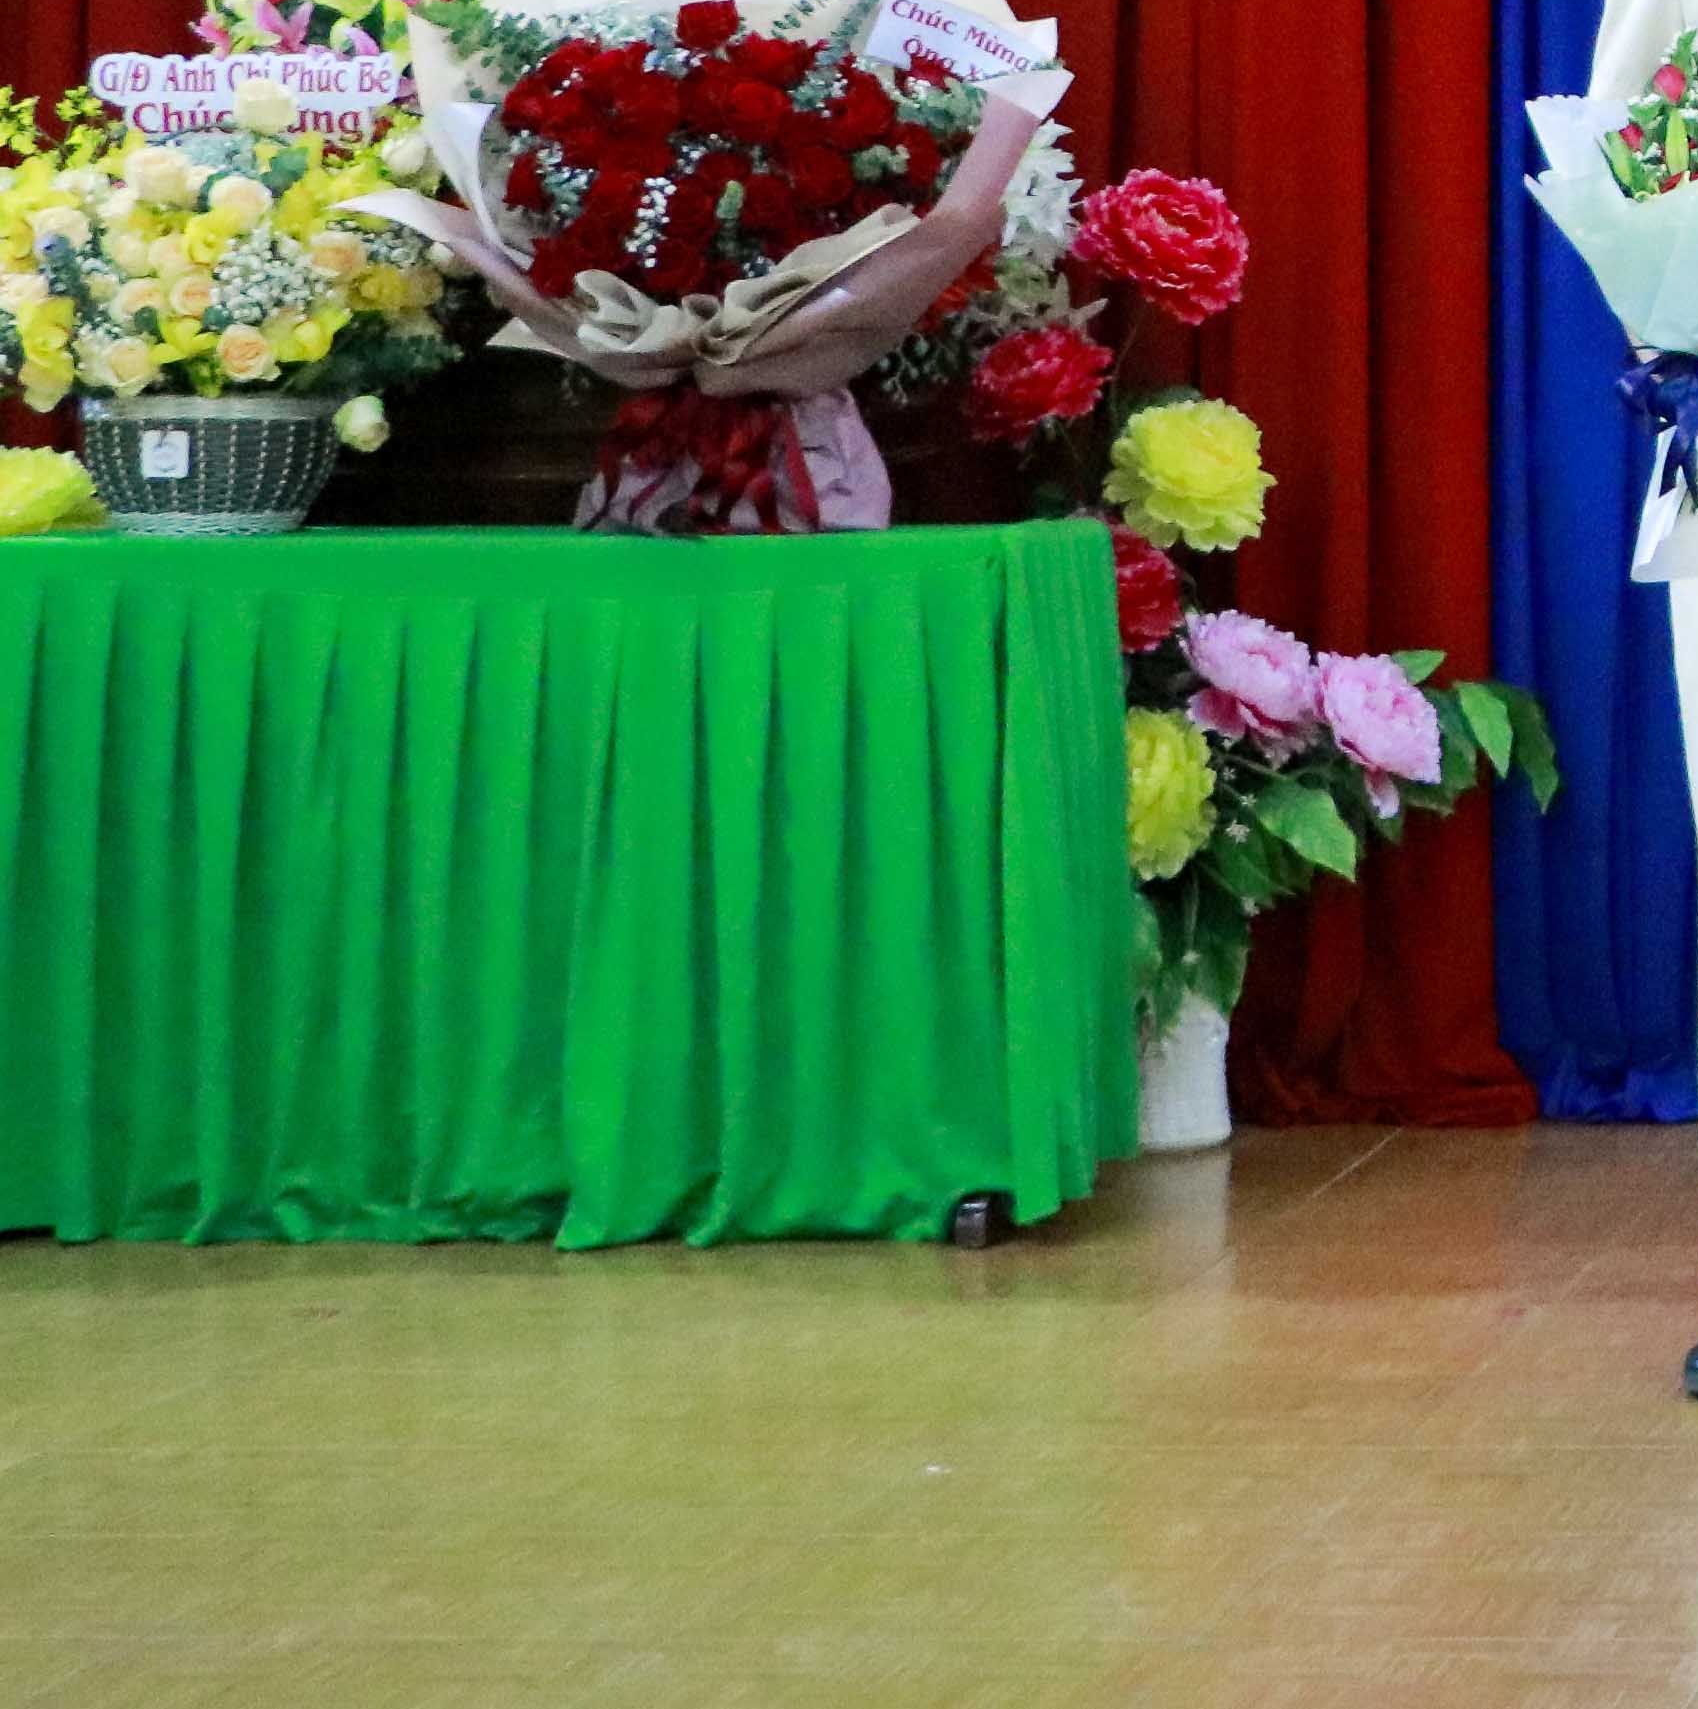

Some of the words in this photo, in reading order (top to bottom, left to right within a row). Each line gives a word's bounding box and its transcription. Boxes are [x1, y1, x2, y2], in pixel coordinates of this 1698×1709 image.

[891, 0, 957, 36] Chúc
[163, 62, 217, 93] Anh
[281, 59, 348, 93] Phúc
